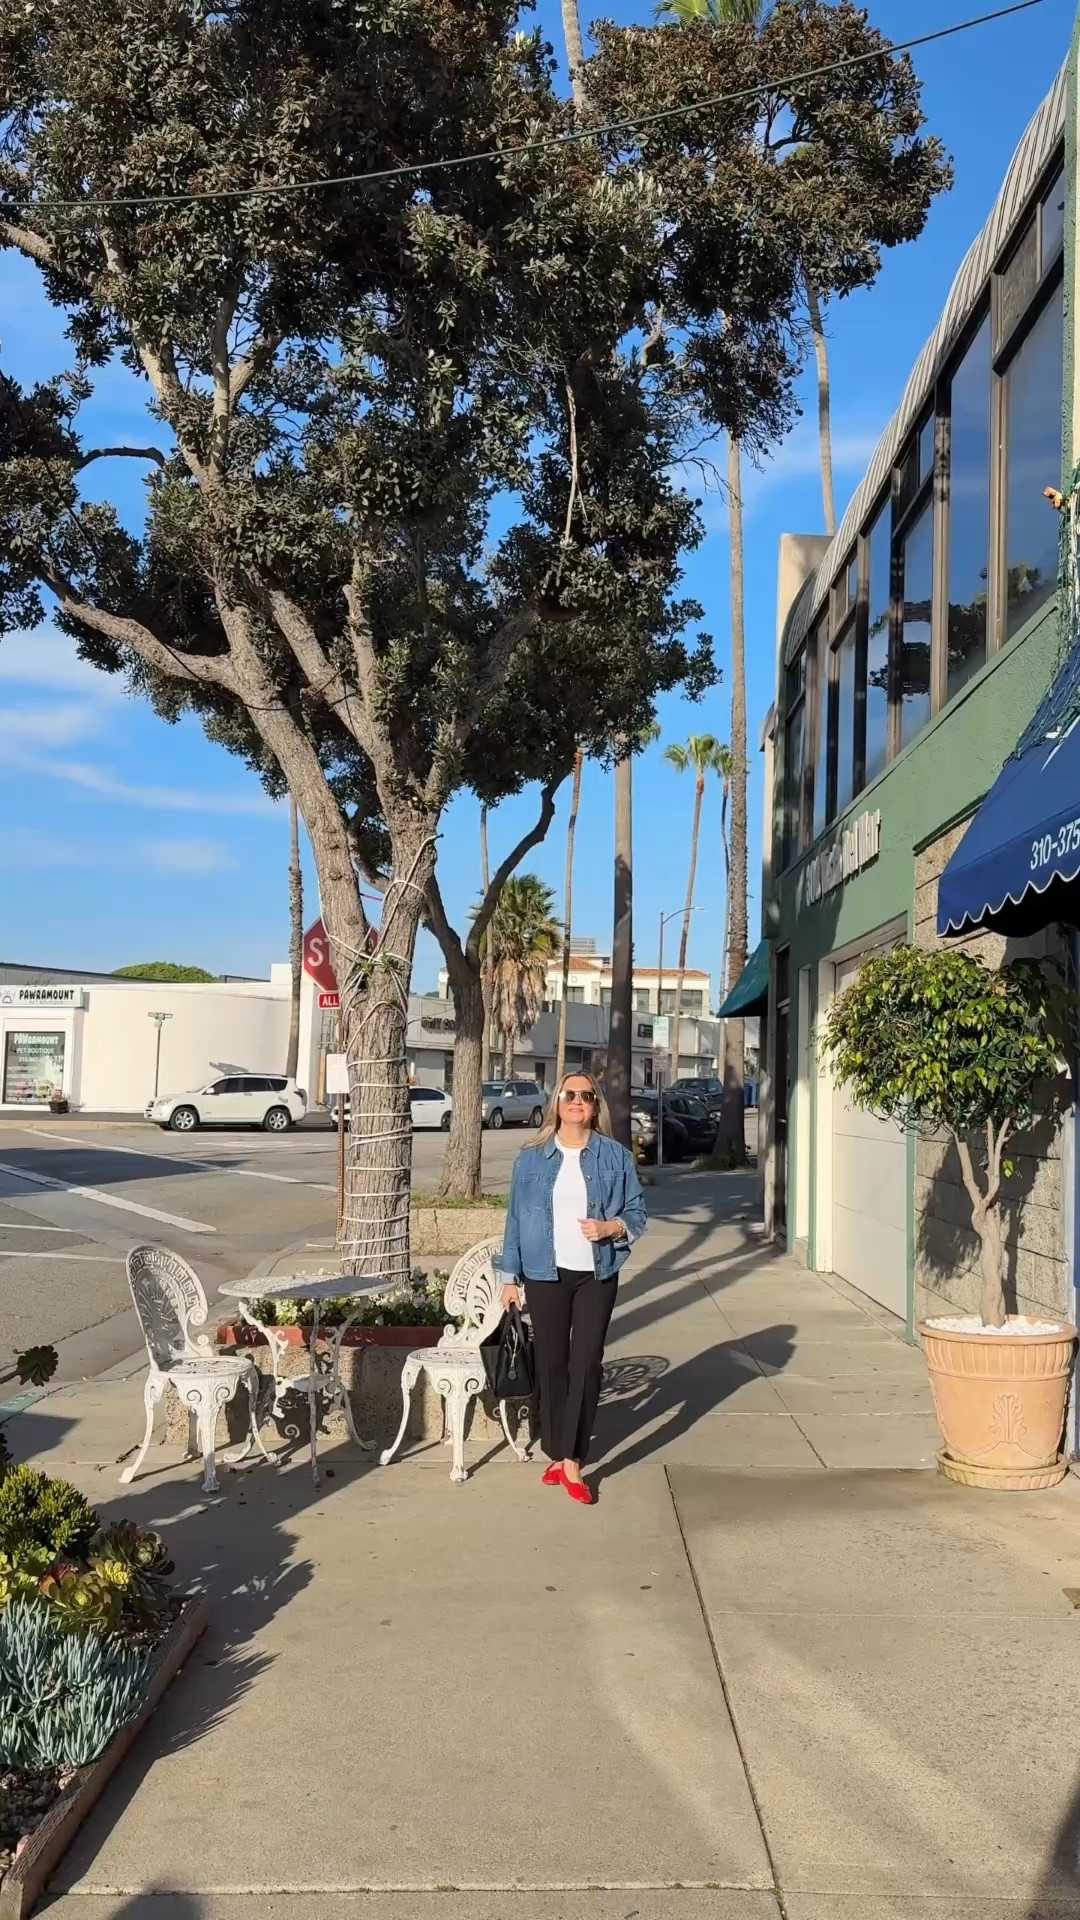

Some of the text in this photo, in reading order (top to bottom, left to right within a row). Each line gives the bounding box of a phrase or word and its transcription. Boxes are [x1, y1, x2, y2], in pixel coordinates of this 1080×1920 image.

[19, 989, 75, 1000] PAWRAMOUNT
[322, 995, 338, 1006] ALL
[14, 1032, 59, 1045] PAWRAMOUNT
